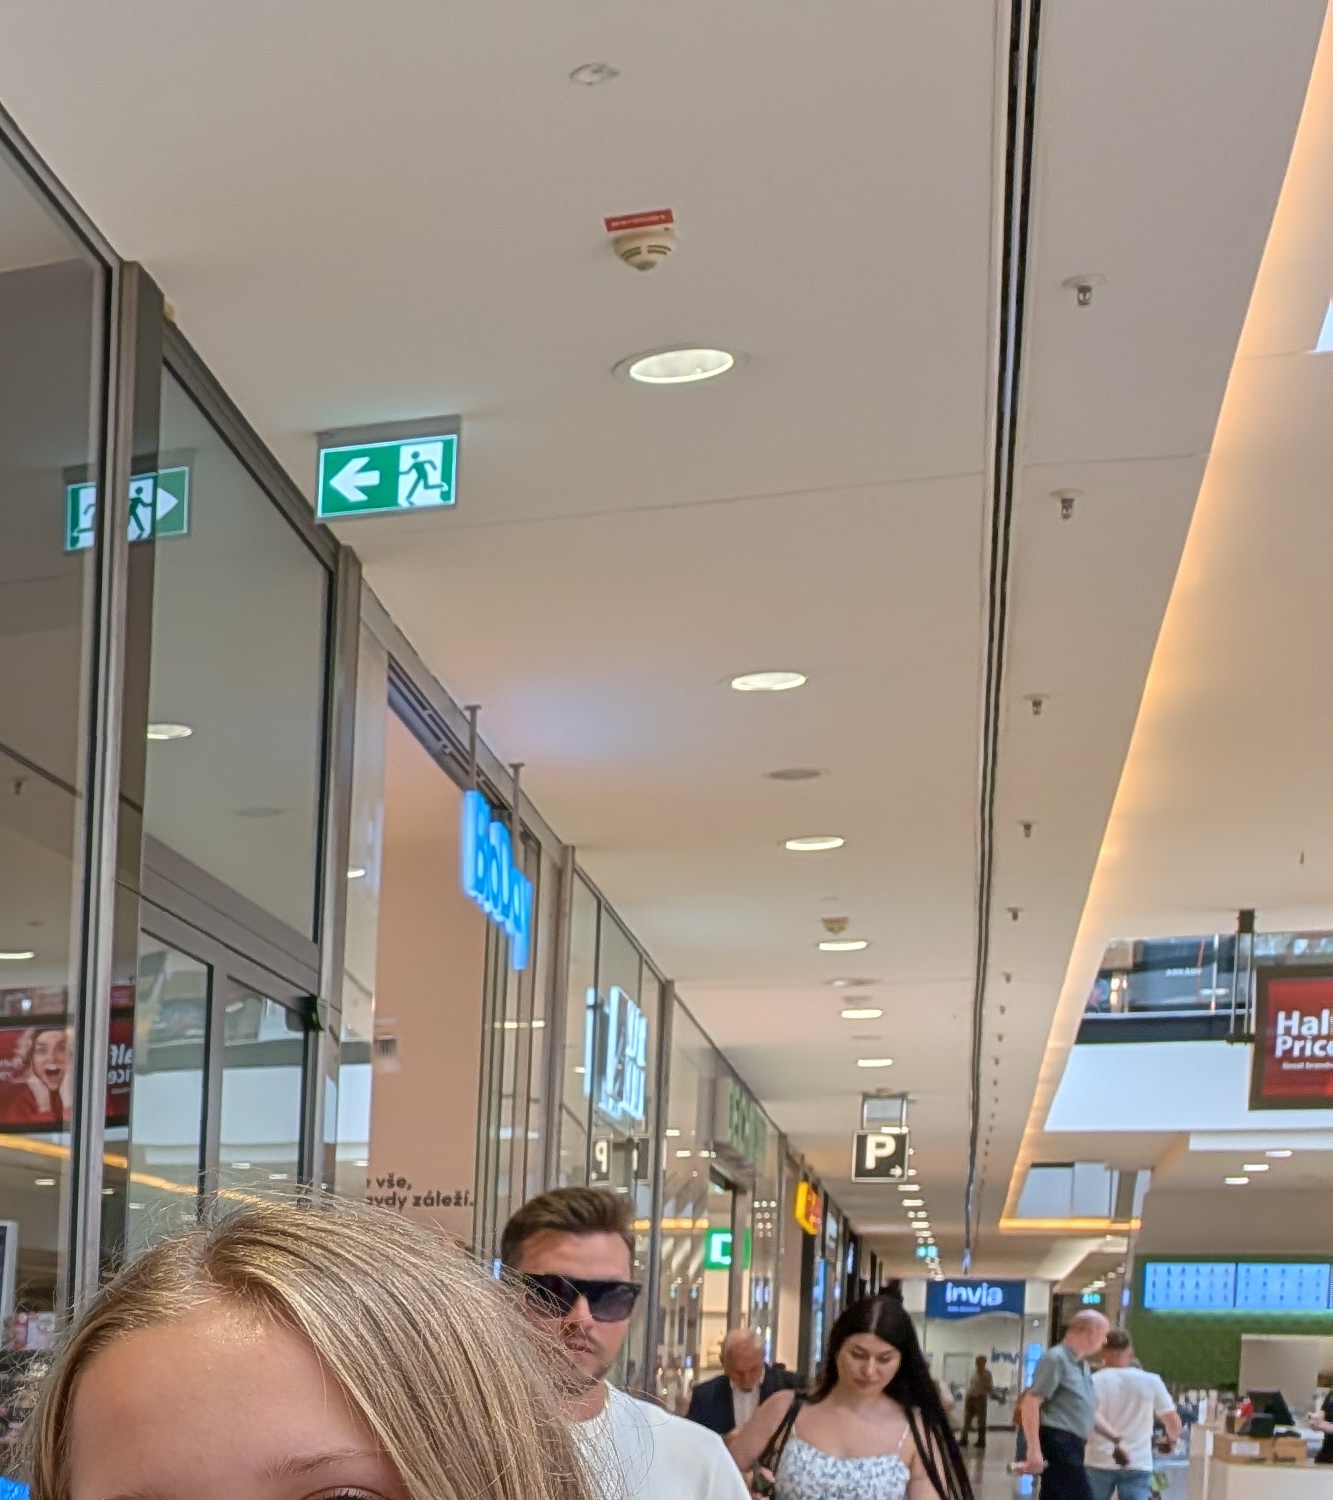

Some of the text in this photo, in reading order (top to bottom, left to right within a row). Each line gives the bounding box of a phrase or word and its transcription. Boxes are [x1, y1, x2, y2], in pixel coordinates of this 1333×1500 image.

[1277, 1009, 1333, 1036] Hal
[865, 1134, 896, 1170] P
[945, 1282, 1003, 1306] invia
